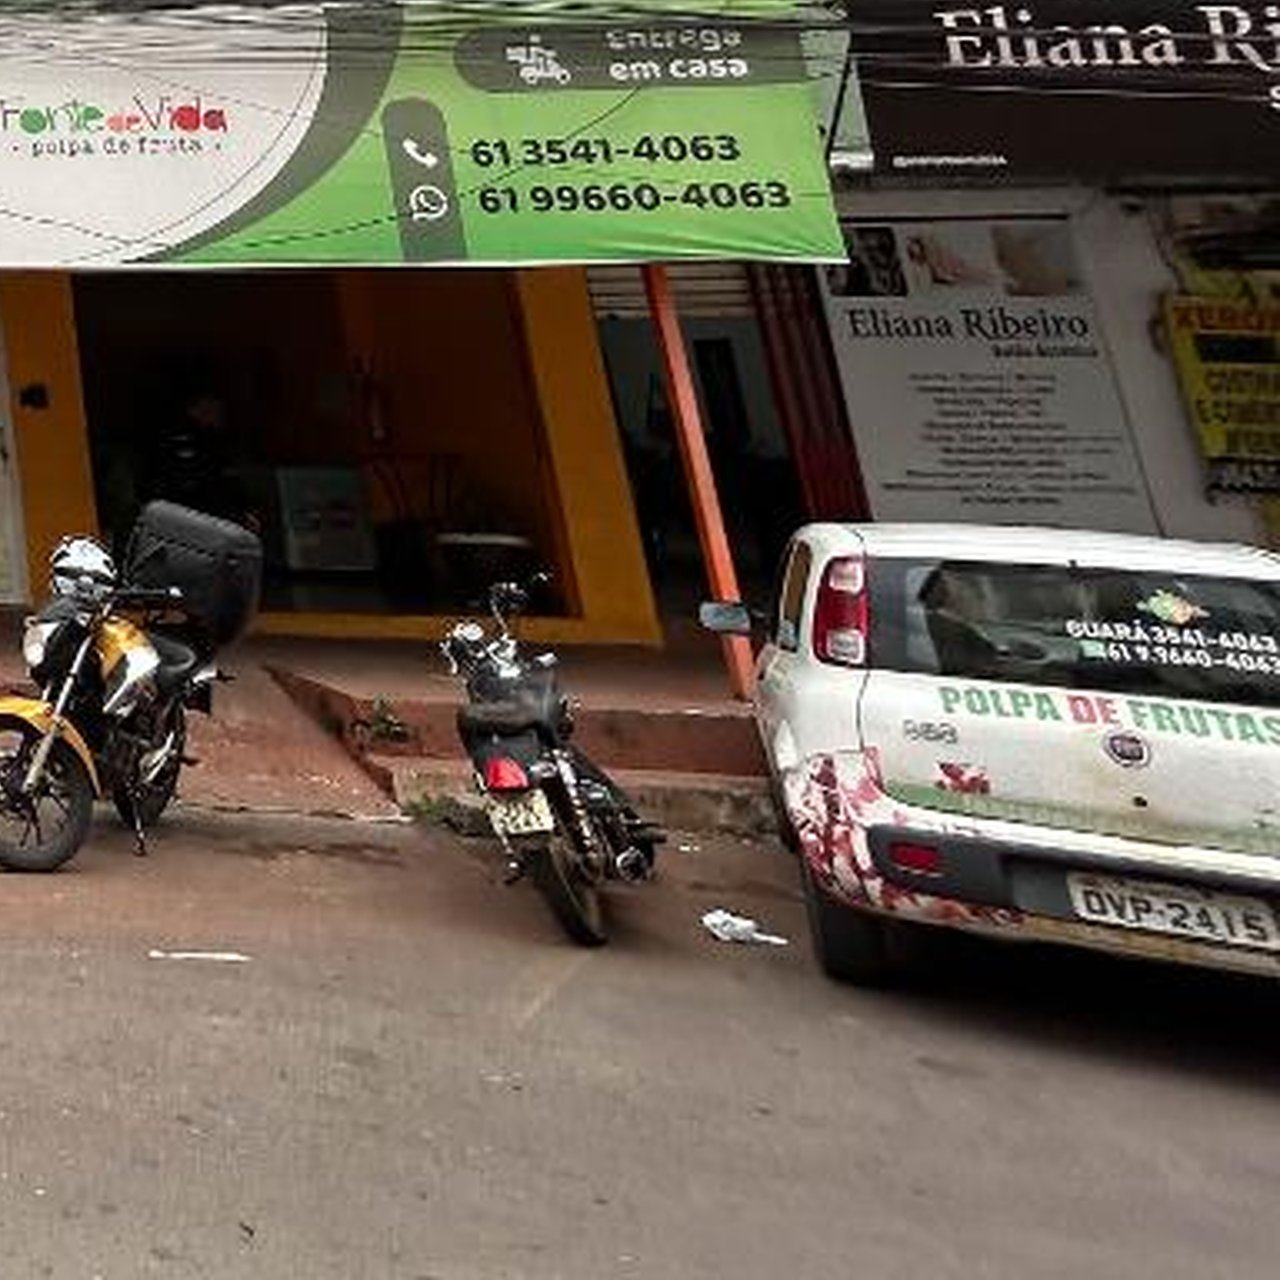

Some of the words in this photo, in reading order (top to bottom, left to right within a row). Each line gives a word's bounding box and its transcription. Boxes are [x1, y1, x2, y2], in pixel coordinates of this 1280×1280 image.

[605, 28, 742, 51] Entrega
[934, 6, 1185, 67] Eliana
[609, 60, 663, 81] em
[668, 58, 749, 79] casa
[133, 94, 228, 133] Vida
[32, 138, 95, 157] polpa
[102, 137, 131, 154] de
[471, 140, 510, 168] 61
[520, 135, 741, 165] 3541-4063
[479, 187, 519, 213] 61
[528, 182, 791, 211] 99660-4063
[846, 309, 954, 338] Eliana
[959, 308, 1090, 341] Ribeiro
[939, 685, 1063, 722] POLPA
[1066, 694, 1120, 724] DE
[1126, 699, 1280, 745] FRUTAS
